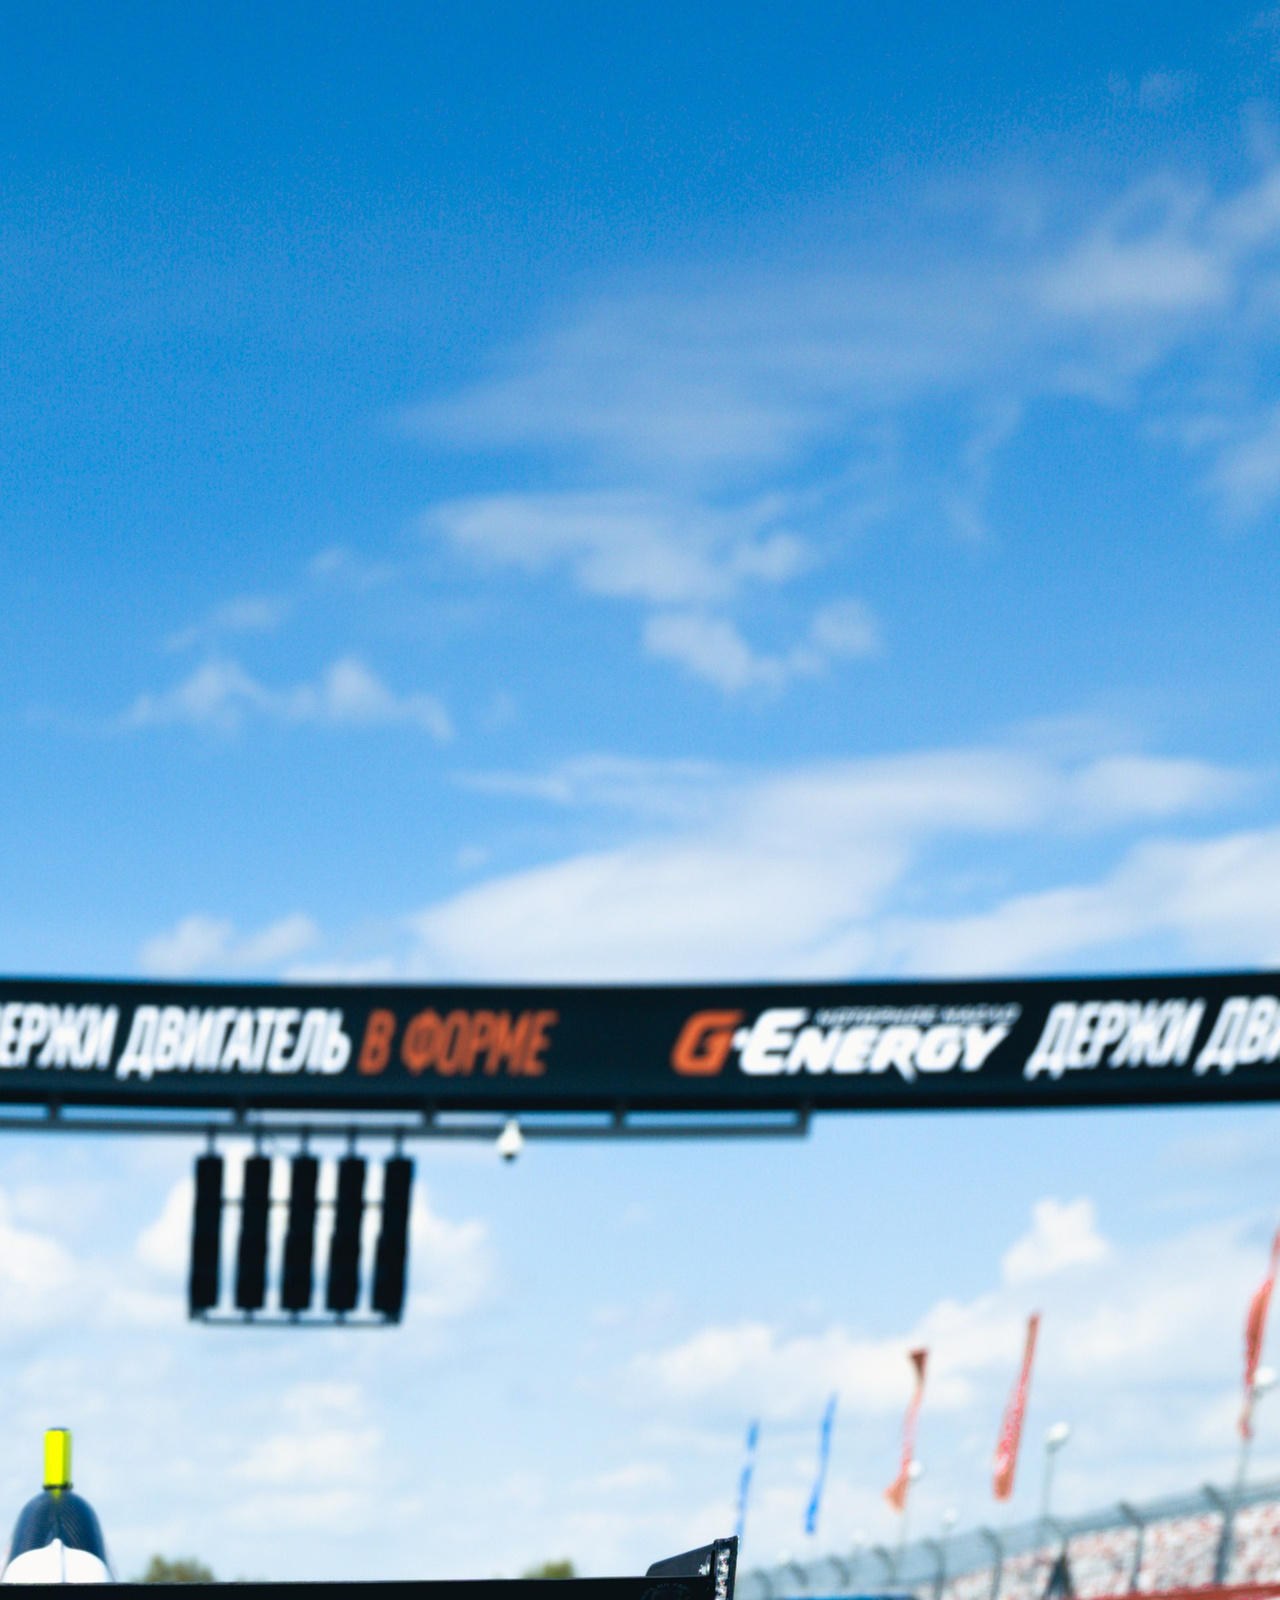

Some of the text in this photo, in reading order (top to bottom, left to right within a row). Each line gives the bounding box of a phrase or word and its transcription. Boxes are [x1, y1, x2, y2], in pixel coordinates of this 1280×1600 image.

[115, 1005, 352, 1082] ДВИГАТЕЛЬ
[356, 1008, 396, 1075] В
[400, 1006, 559, 1077] ФОРМЕ
[1023, 999, 1207, 1081] ДЕРЖИ
